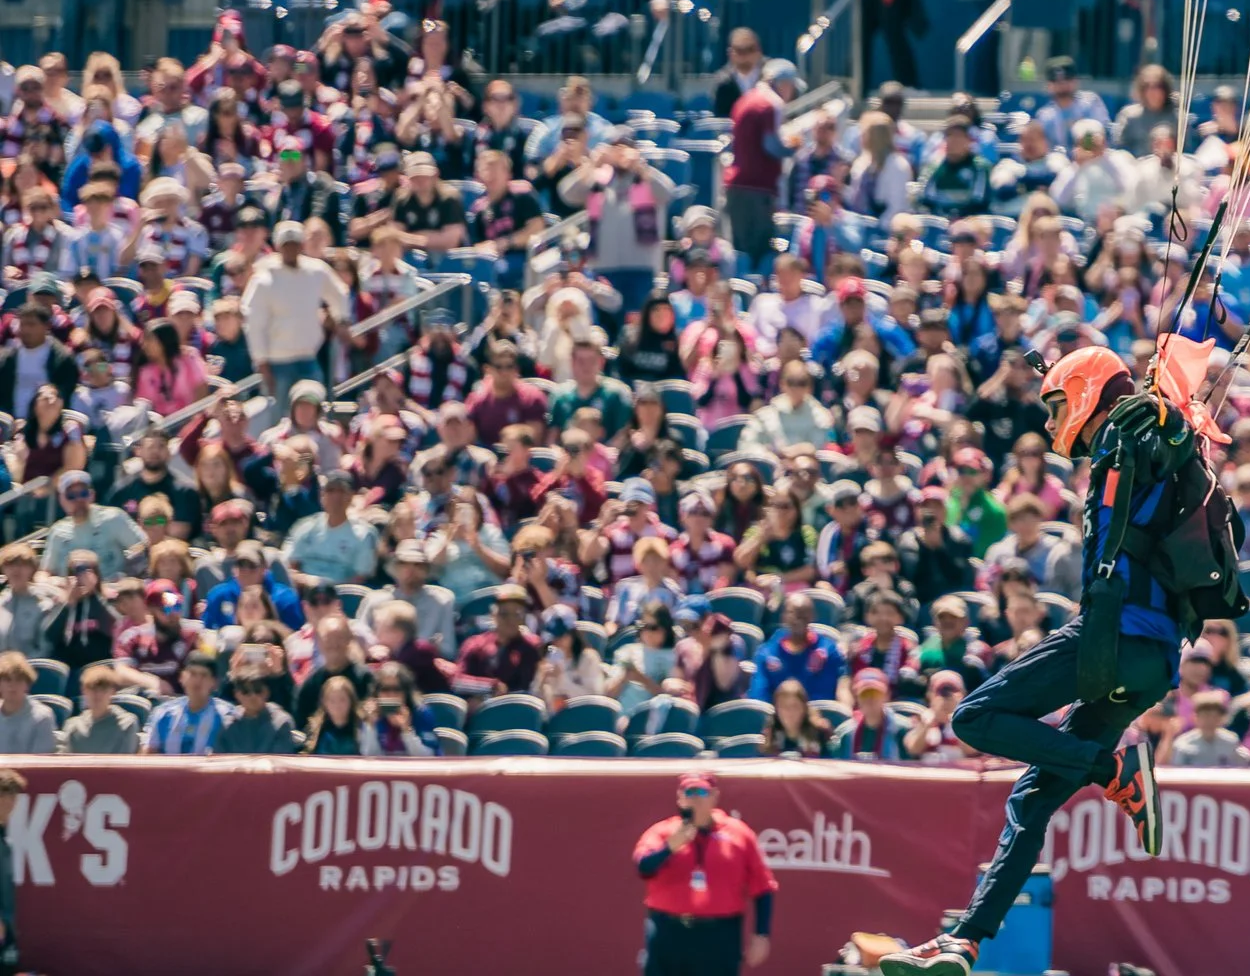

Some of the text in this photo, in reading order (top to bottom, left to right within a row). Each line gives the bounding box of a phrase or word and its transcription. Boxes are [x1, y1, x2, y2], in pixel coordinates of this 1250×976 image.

[270, 780, 513, 877] COLORADO
[731, 810, 872, 870] ealth
[319, 865, 460, 892] RAPIDS
[1087, 875, 1232, 904] RAPIDS
